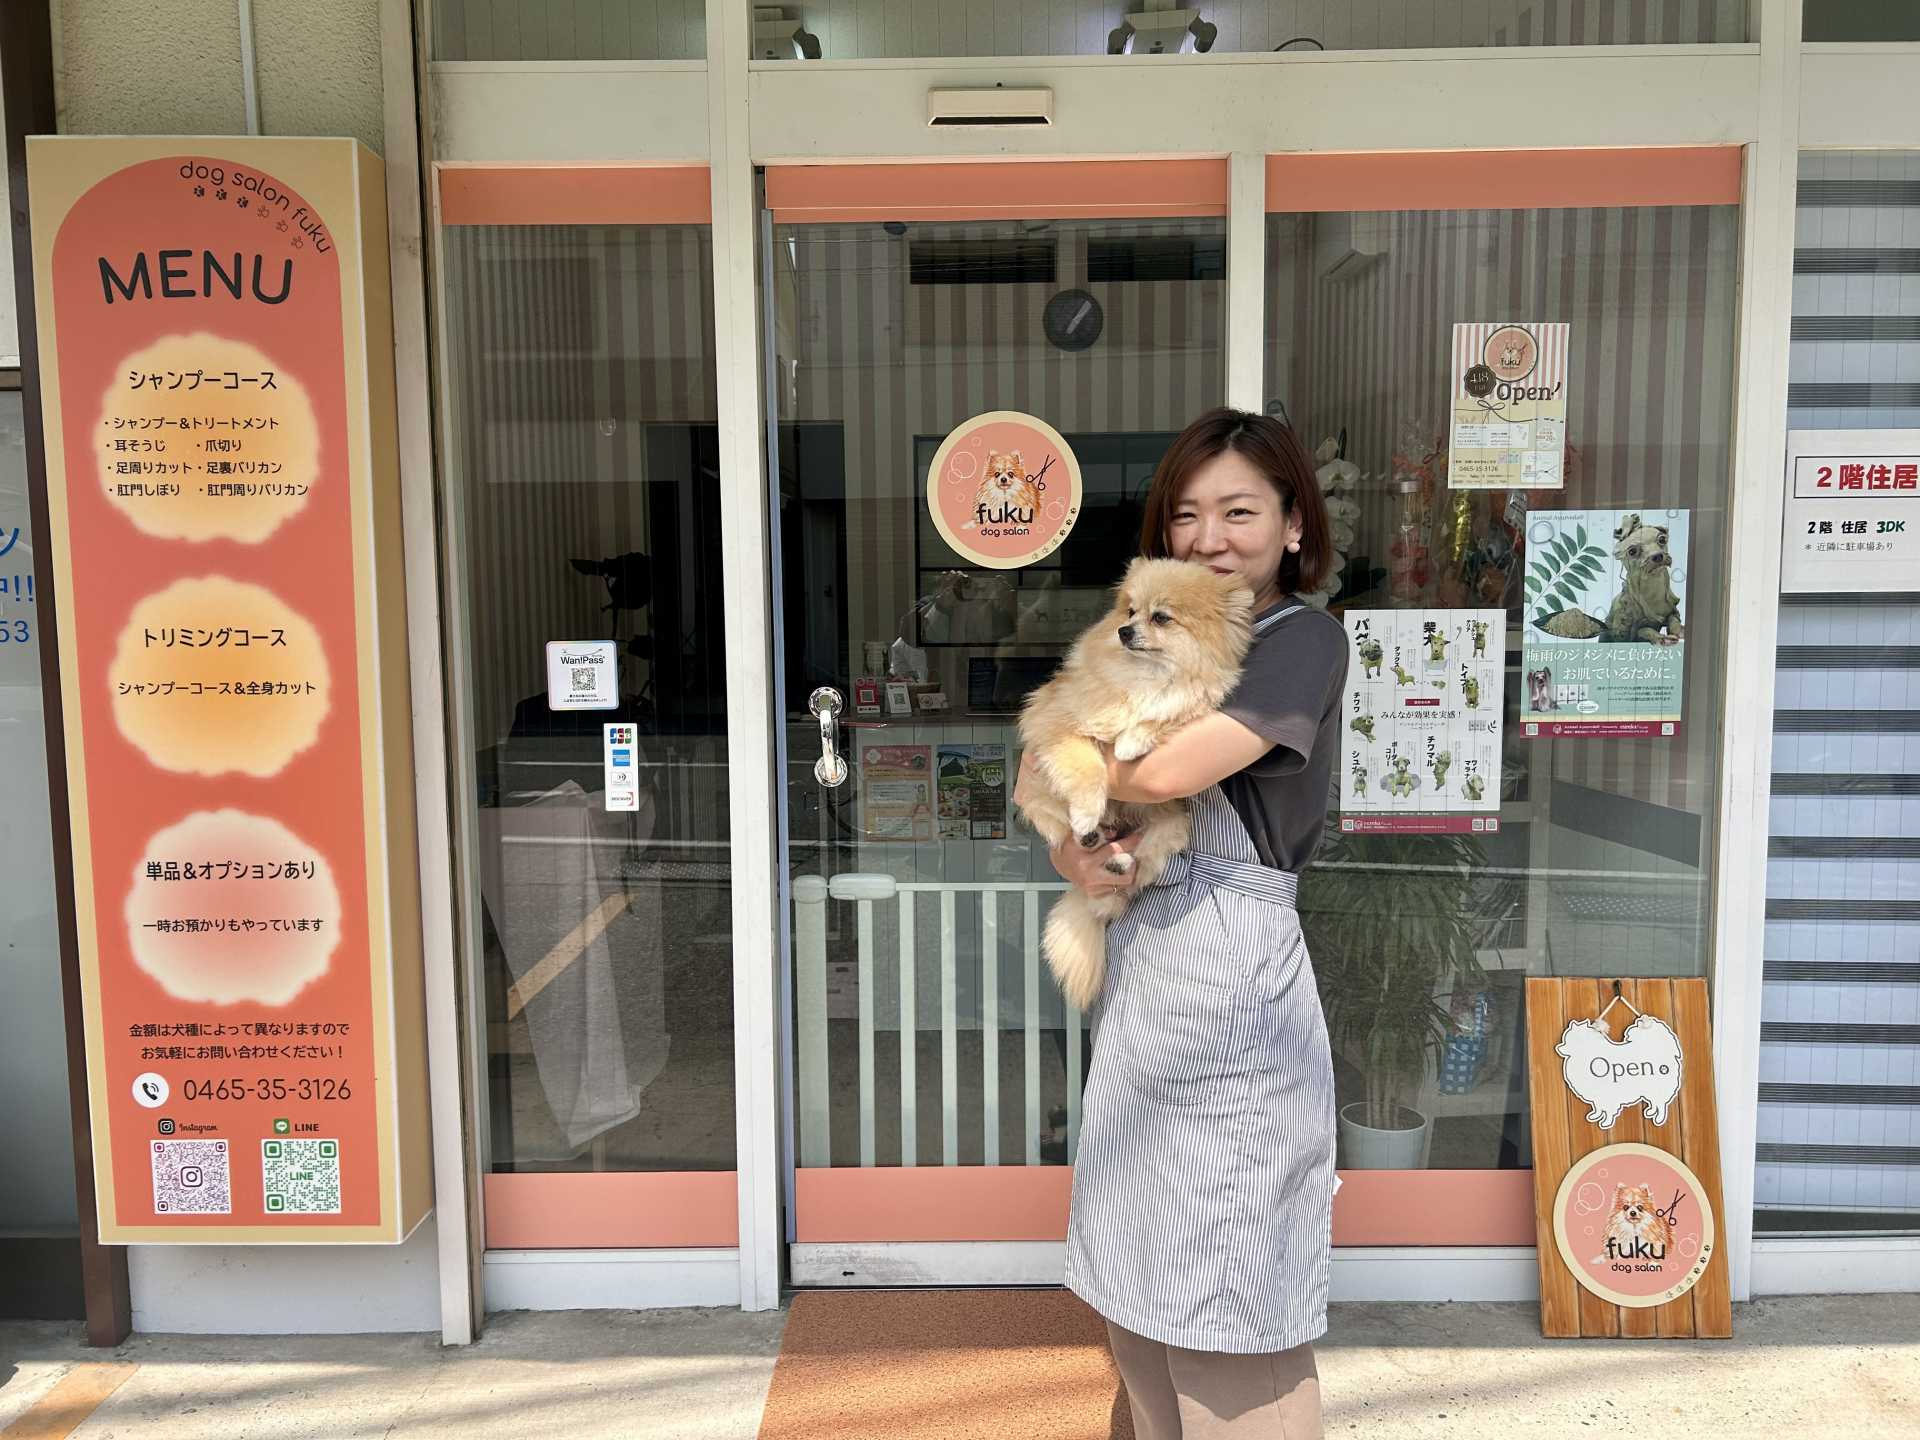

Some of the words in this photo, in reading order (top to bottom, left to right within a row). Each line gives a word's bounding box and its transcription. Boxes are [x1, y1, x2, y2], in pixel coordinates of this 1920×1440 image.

[179, 161, 225, 185] dog
[231, 171, 290, 211] salon
[291, 207, 331, 254] fuku
[98, 249, 293, 304] MENU
[129, 369, 278, 390] シャンプーコース
[1816, 463, 1919, 491] 2階住居
[976, 501, 1034, 525] fuku
[980, 527, 1001, 538] dog
[1002, 526, 1030, 536] salon
[1841, 520, 1868, 534] 住居
[1876, 520, 1905, 534] 3DK
[145, 627, 287, 648] トリミングコース
[1525, 648, 1682, 663] 梅雨のジメジメに負けない
[118, 681, 317, 696] シャンプーコース&全身カット
[1353, 691, 1361, 714] チワワ
[1426, 735, 1436, 768] チワマル
[146, 860, 316, 881] 単品&オプションあり
[143, 918, 324, 933] 一時お預かりもやっています
[128, 1023, 350, 1037] 金額は犬種によって異なりますので
[141, 1045, 343, 1060] お気軽にお問い合わせください！
[1589, 1056, 1654, 1083] Open
[183, 1078, 351, 1101] 0465-35-3126
[179, 1123, 218, 1134] Instagram
[294, 1123, 320, 1132] LINE
[289, 1171, 315, 1182] LINE
[1606, 1236, 1666, 1260] fuku
[1611, 1262, 1632, 1274] dog
[1634, 1262, 1663, 1272] salon
